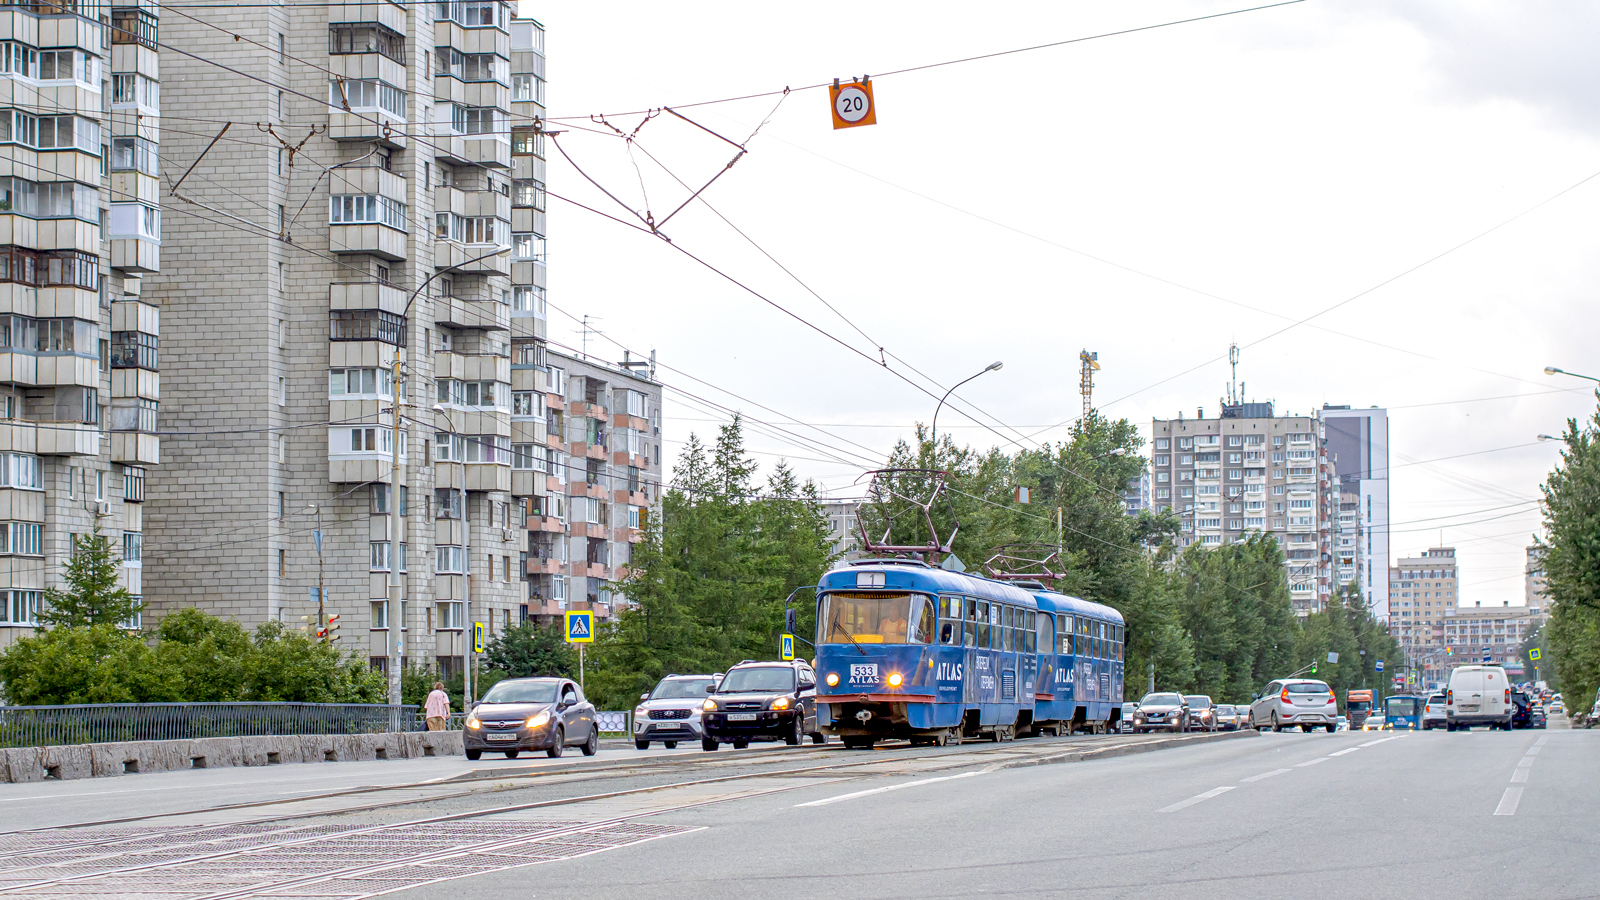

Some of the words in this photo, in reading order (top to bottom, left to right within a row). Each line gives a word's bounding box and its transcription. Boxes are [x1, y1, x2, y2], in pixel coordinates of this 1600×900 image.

[842, 96, 863, 113] 20
[869, 574, 875, 587] 1
[854, 666, 874, 676] 533
[936, 663, 962, 681] ATLAS
[1055, 668, 1074, 683] ATLAS
[848, 675, 880, 684] ATLAS
